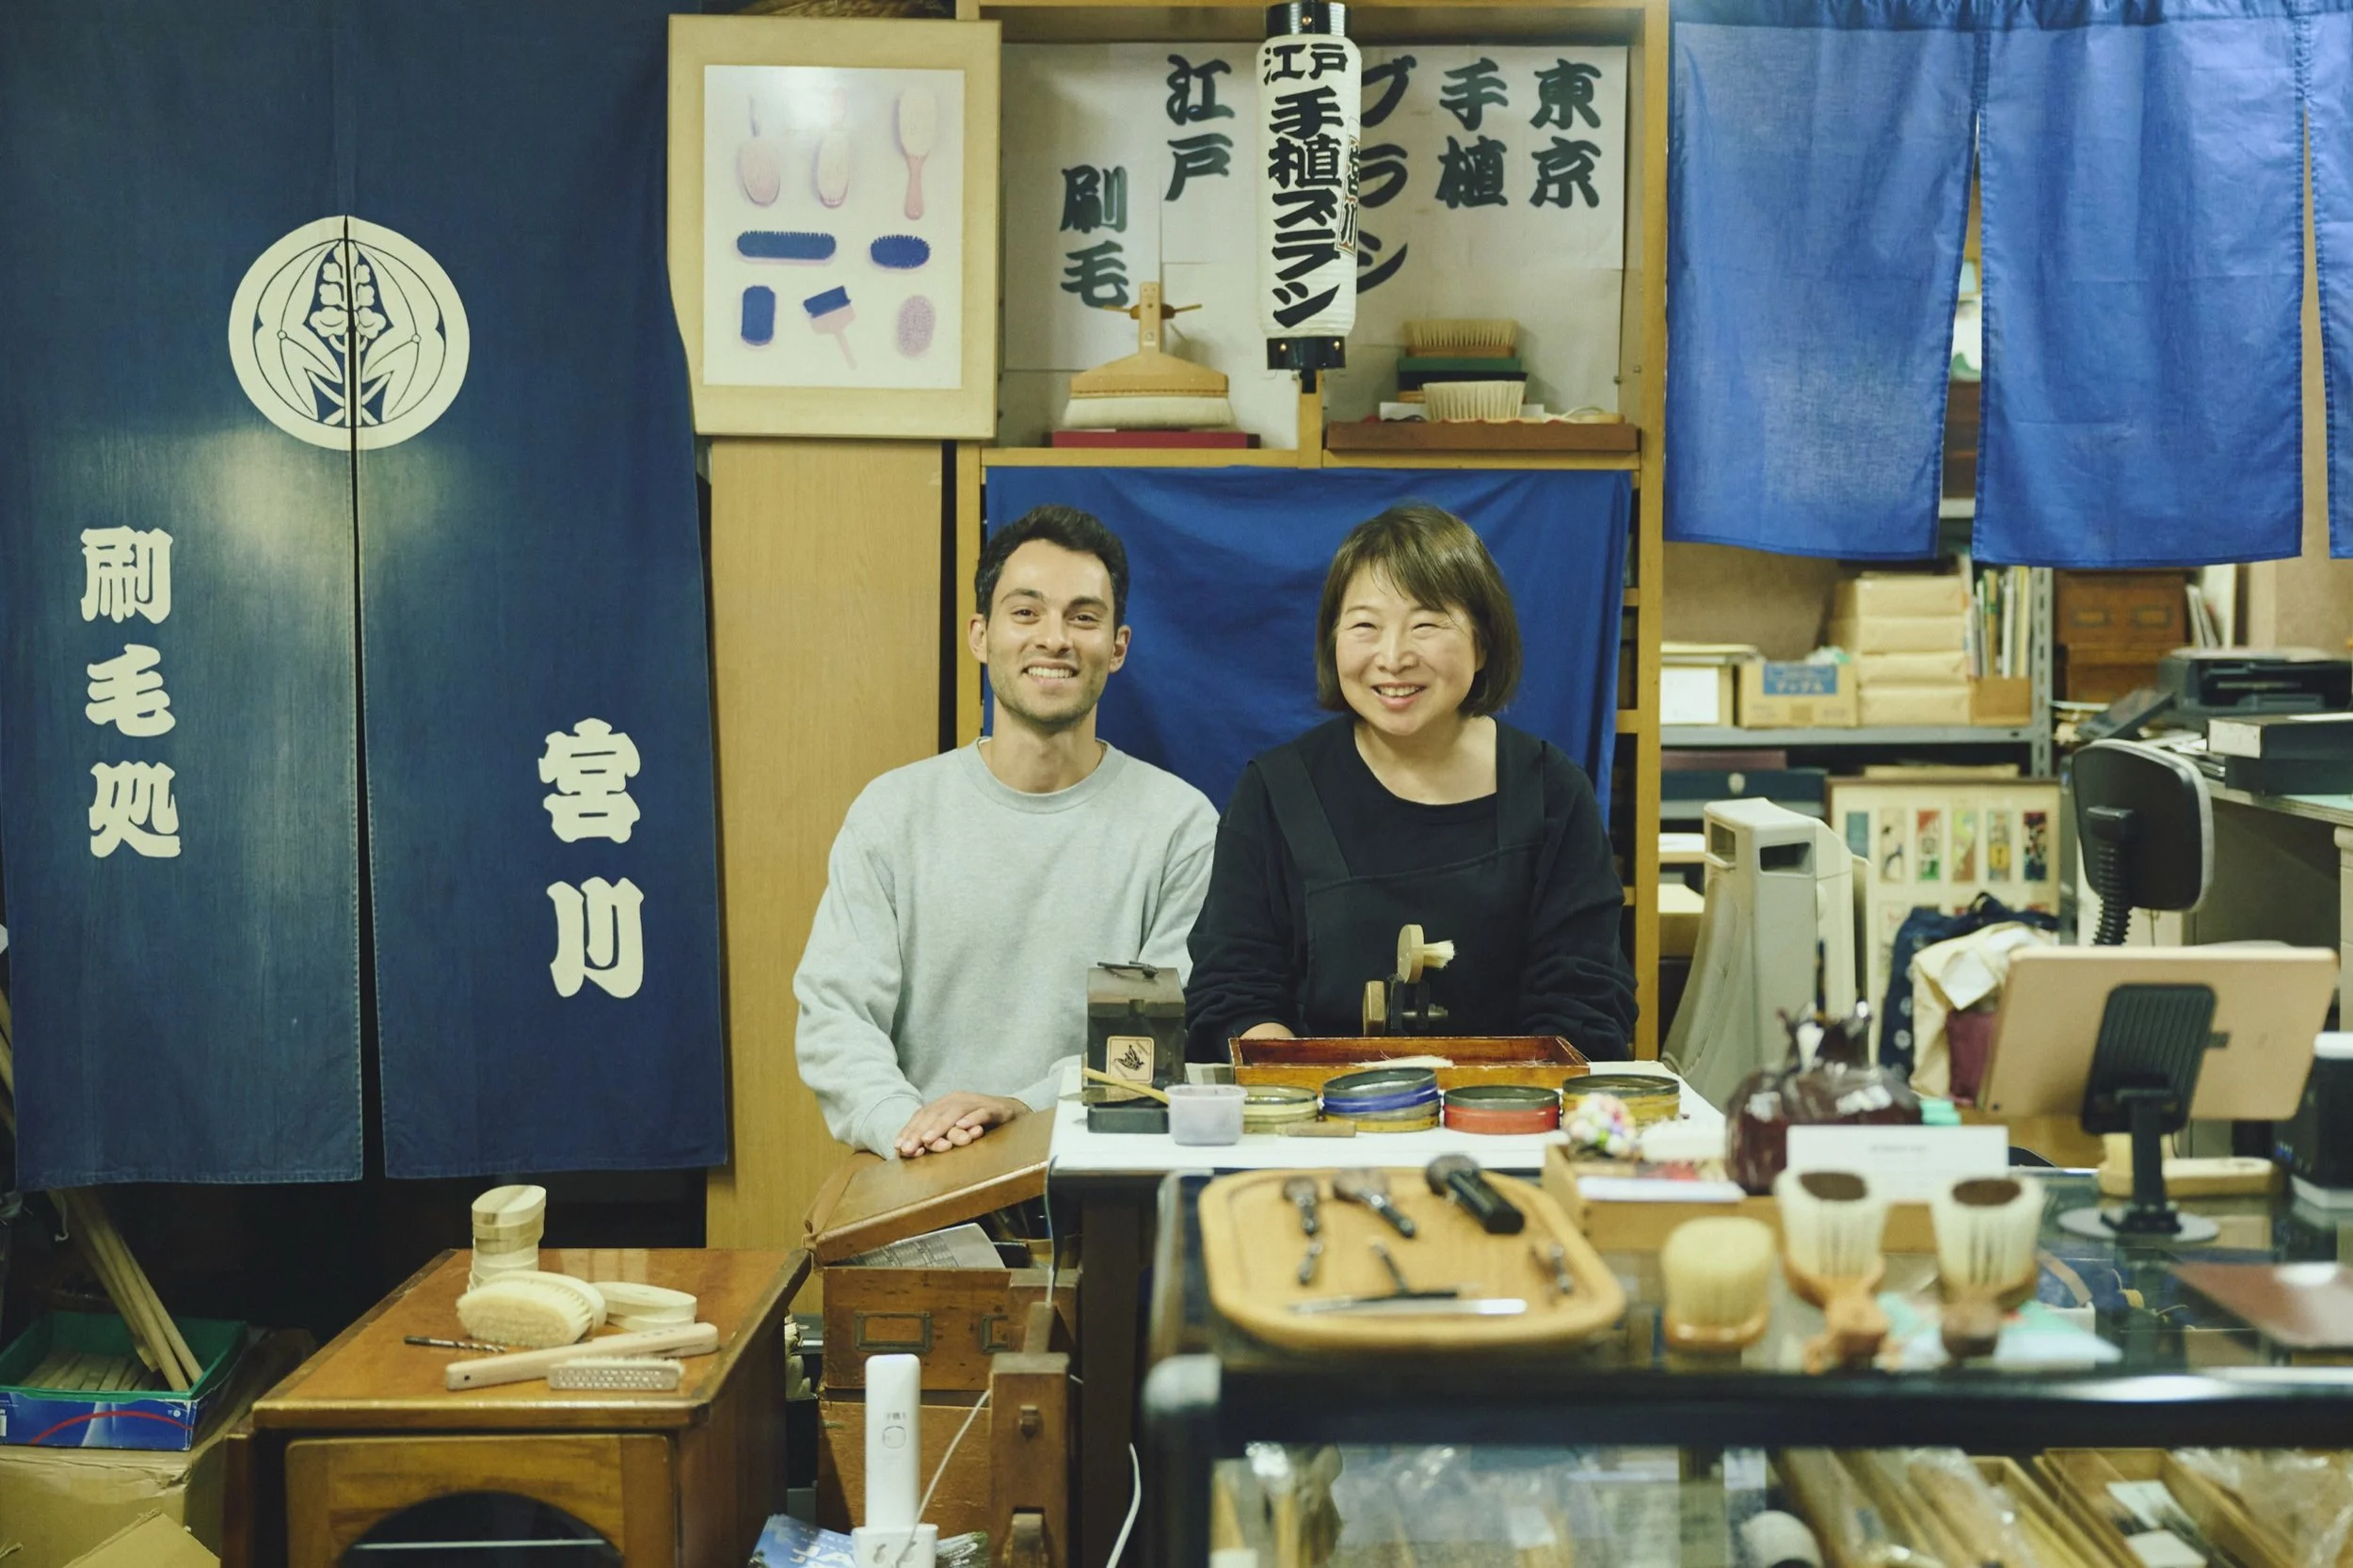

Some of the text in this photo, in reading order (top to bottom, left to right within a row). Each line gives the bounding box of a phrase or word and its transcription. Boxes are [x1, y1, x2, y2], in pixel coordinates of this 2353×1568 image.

[1164, 53, 1236, 201] 江戸
[1264, 43, 1348, 86] 江戸
[1434, 57, 1510, 209] 手植
[1529, 57, 1602, 209] 東京
[1059, 164, 1128, 309] 刷毛
[80, 524, 182, 858] 刷毛処
[537, 717, 645, 1000] 宮川
